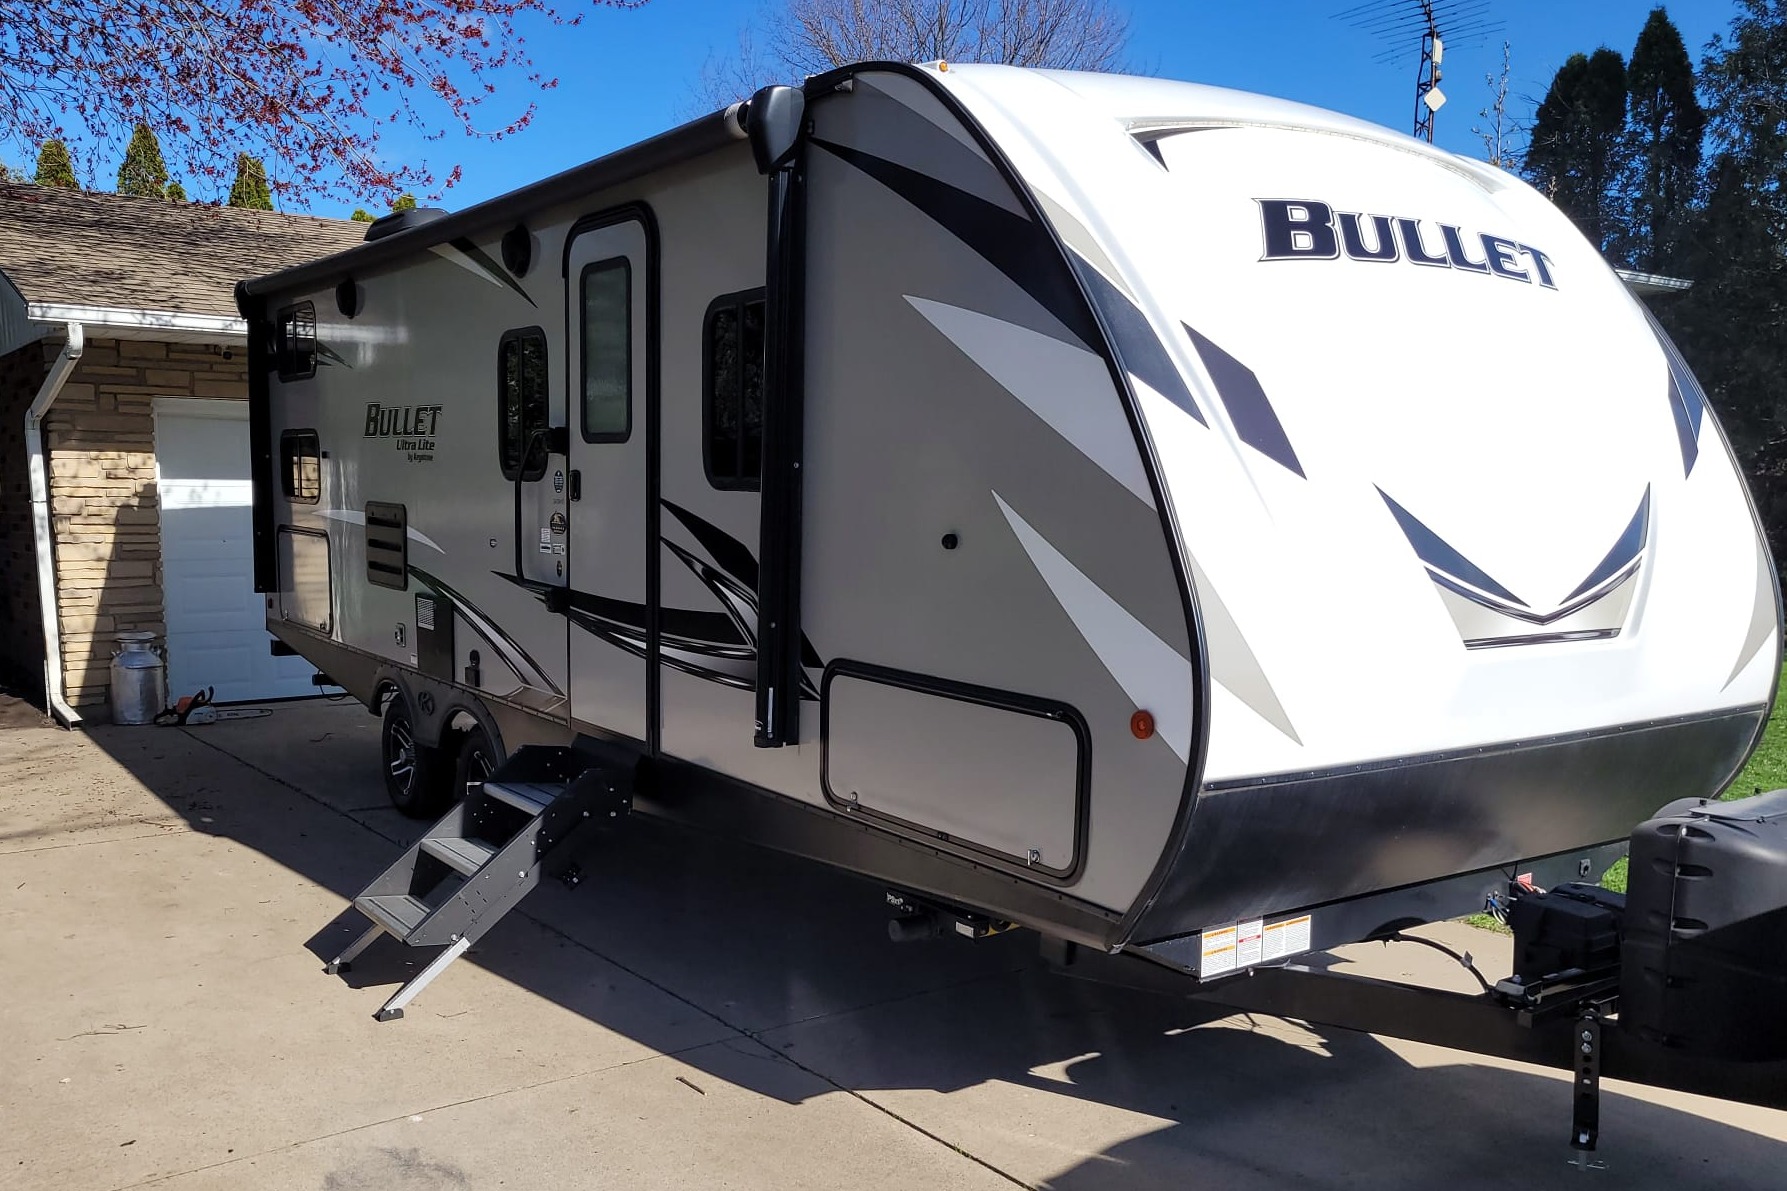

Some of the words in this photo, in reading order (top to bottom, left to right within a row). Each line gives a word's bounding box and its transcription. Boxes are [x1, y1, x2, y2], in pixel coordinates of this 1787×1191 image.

[1251, 198, 1559, 291] BULLET
[362, 402, 443, 438] BULLET
[396, 439, 416, 450] Ultra
[417, 438, 435, 450] Lite
